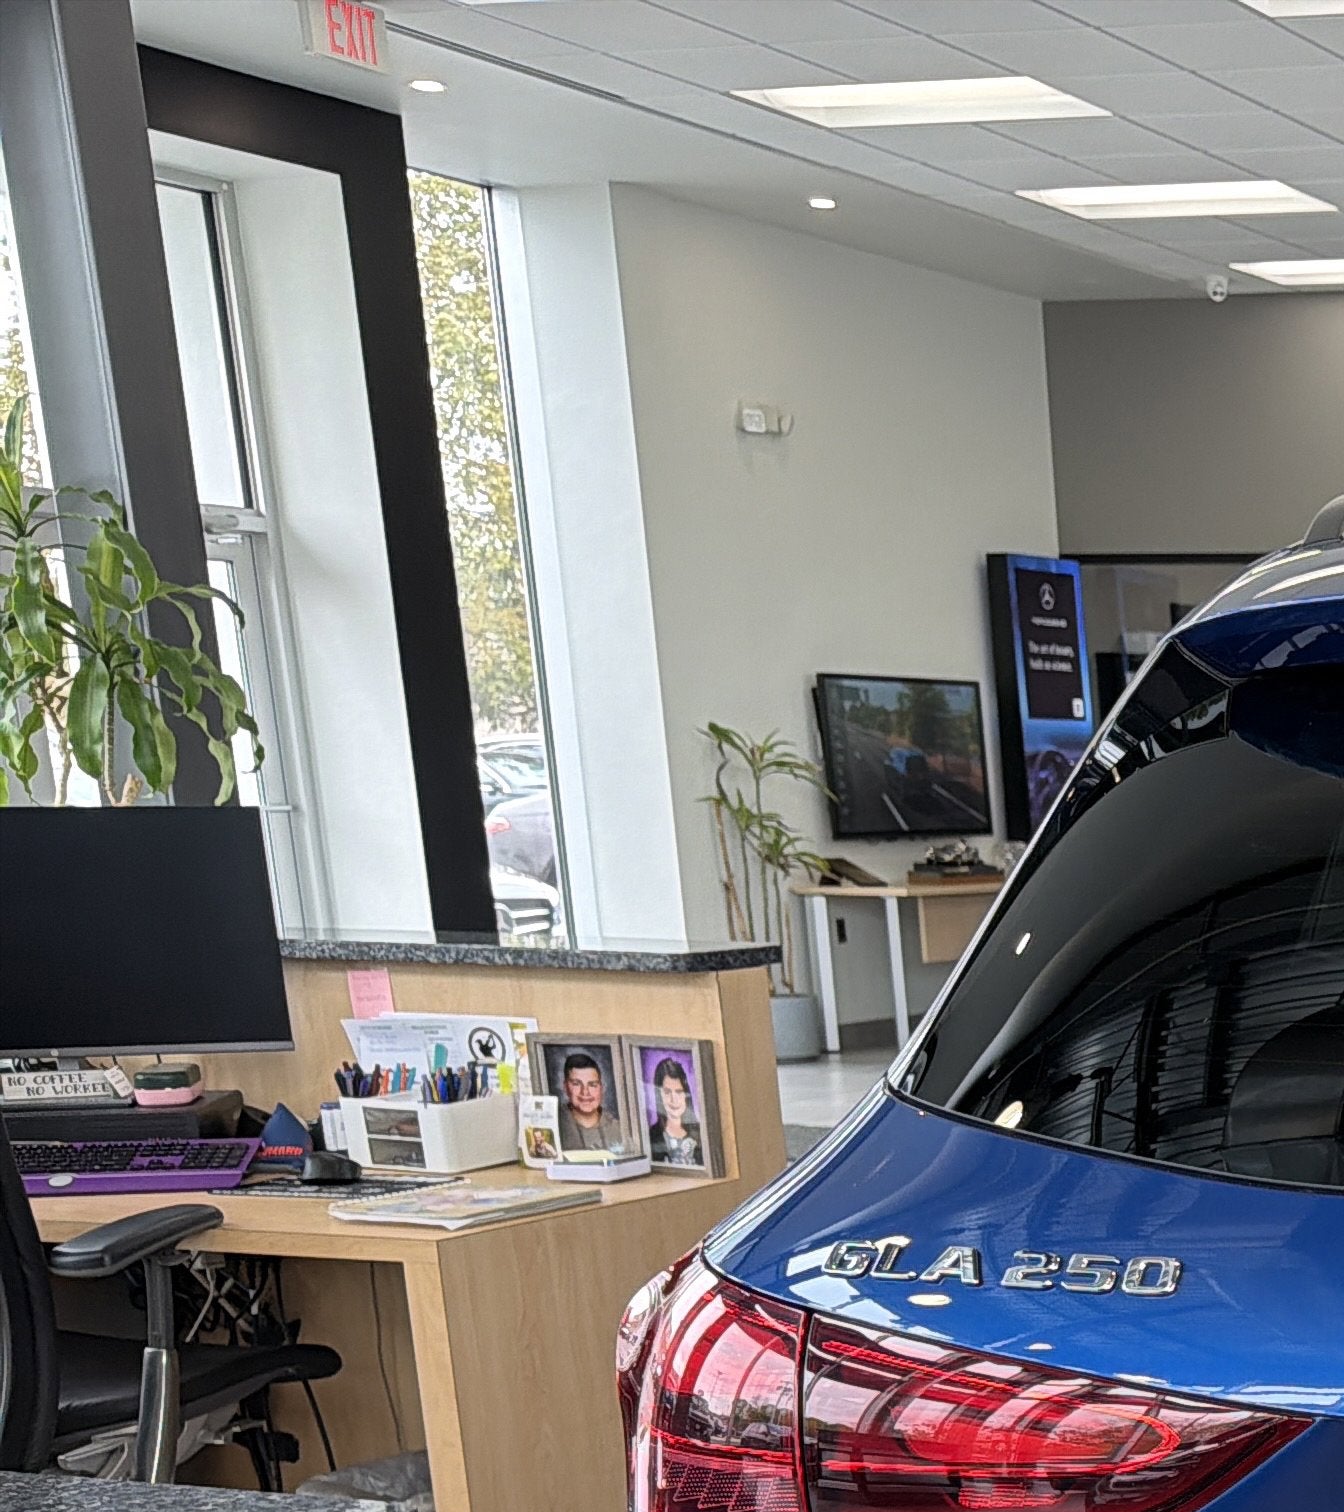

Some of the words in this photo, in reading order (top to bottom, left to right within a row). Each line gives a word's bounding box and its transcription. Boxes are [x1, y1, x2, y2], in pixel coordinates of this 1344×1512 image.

[324, 0, 378, 65] EXIT
[7, 1075, 27, 1087] NO
[33, 1072, 87, 1085] COFFEE
[26, 1085, 46, 1097] NO
[820, 1240, 984, 1288] GLA
[1000, 1249, 1185, 1298] 250
